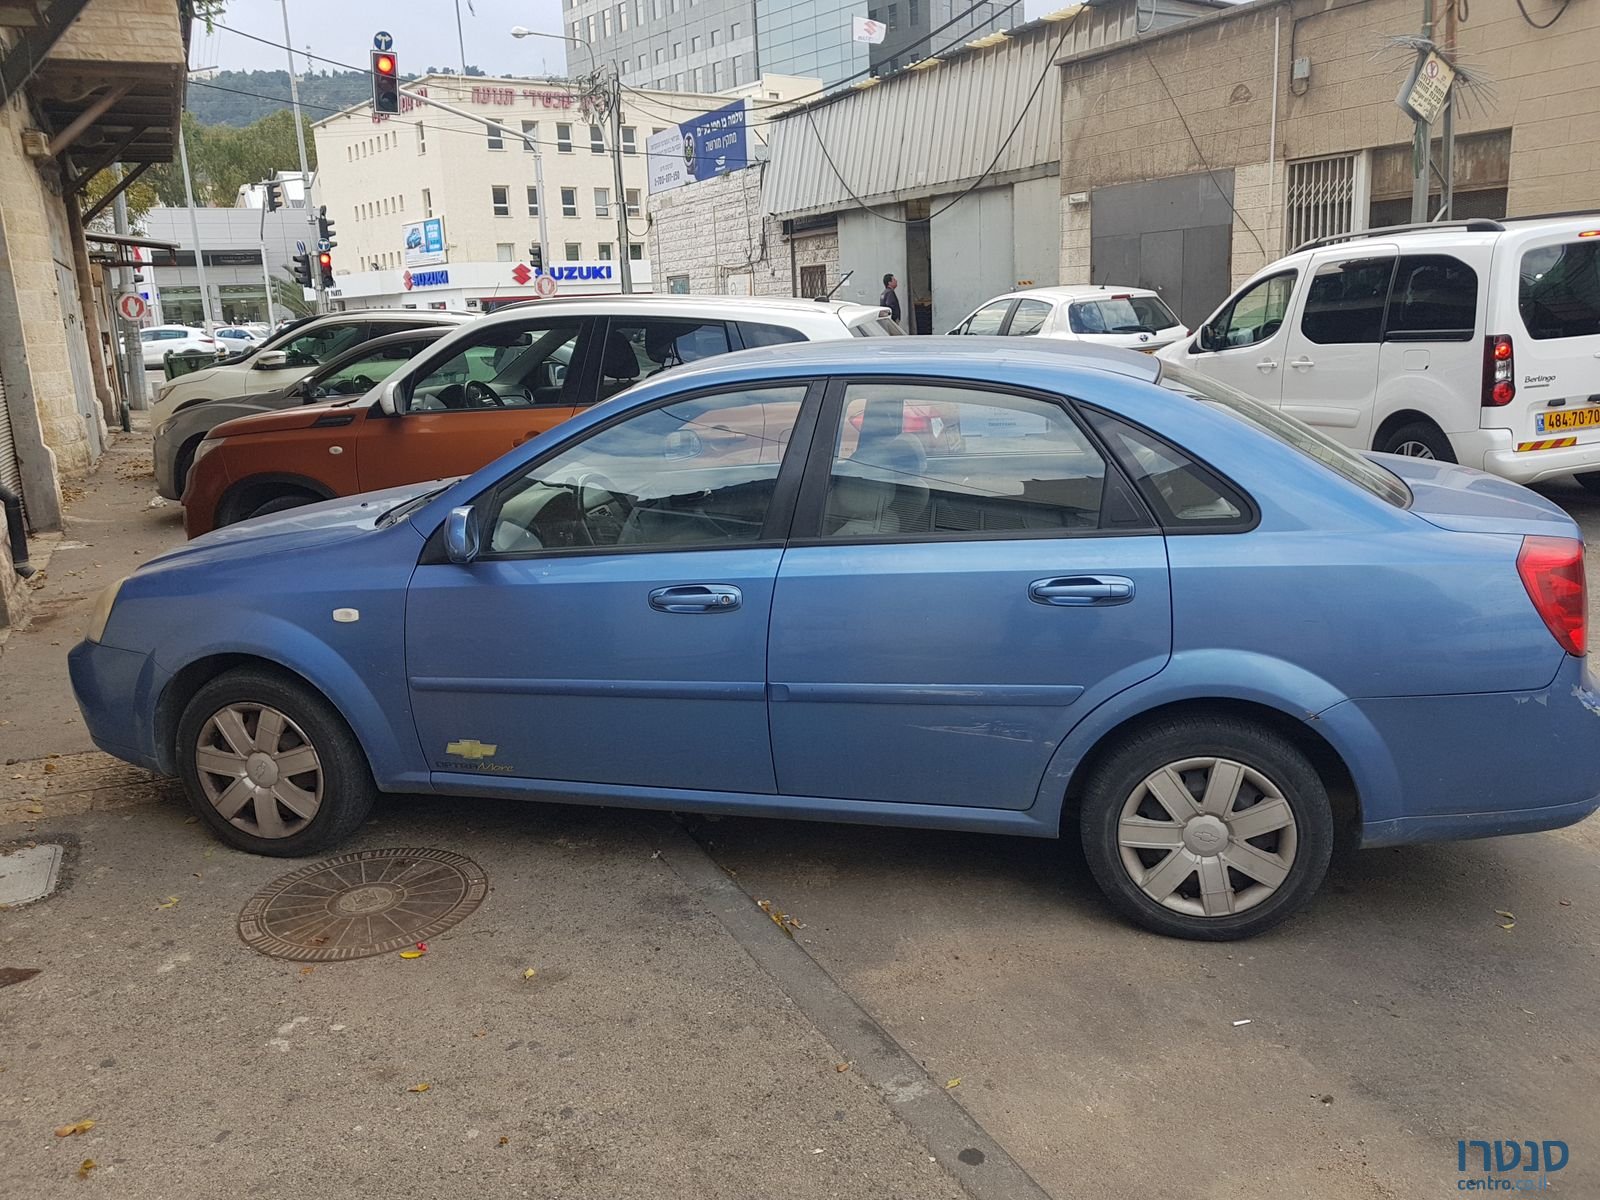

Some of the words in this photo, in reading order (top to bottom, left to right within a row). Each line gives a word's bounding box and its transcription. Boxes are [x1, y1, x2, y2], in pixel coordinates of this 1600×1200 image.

[471, 86, 515, 106] תנועה
[705, 137, 722, 153] מורשה
[721, 131, 738, 150] מתקין
[412, 270, 449, 287] SUZUKI
[1524, 375, 1557, 384] Berlingo
